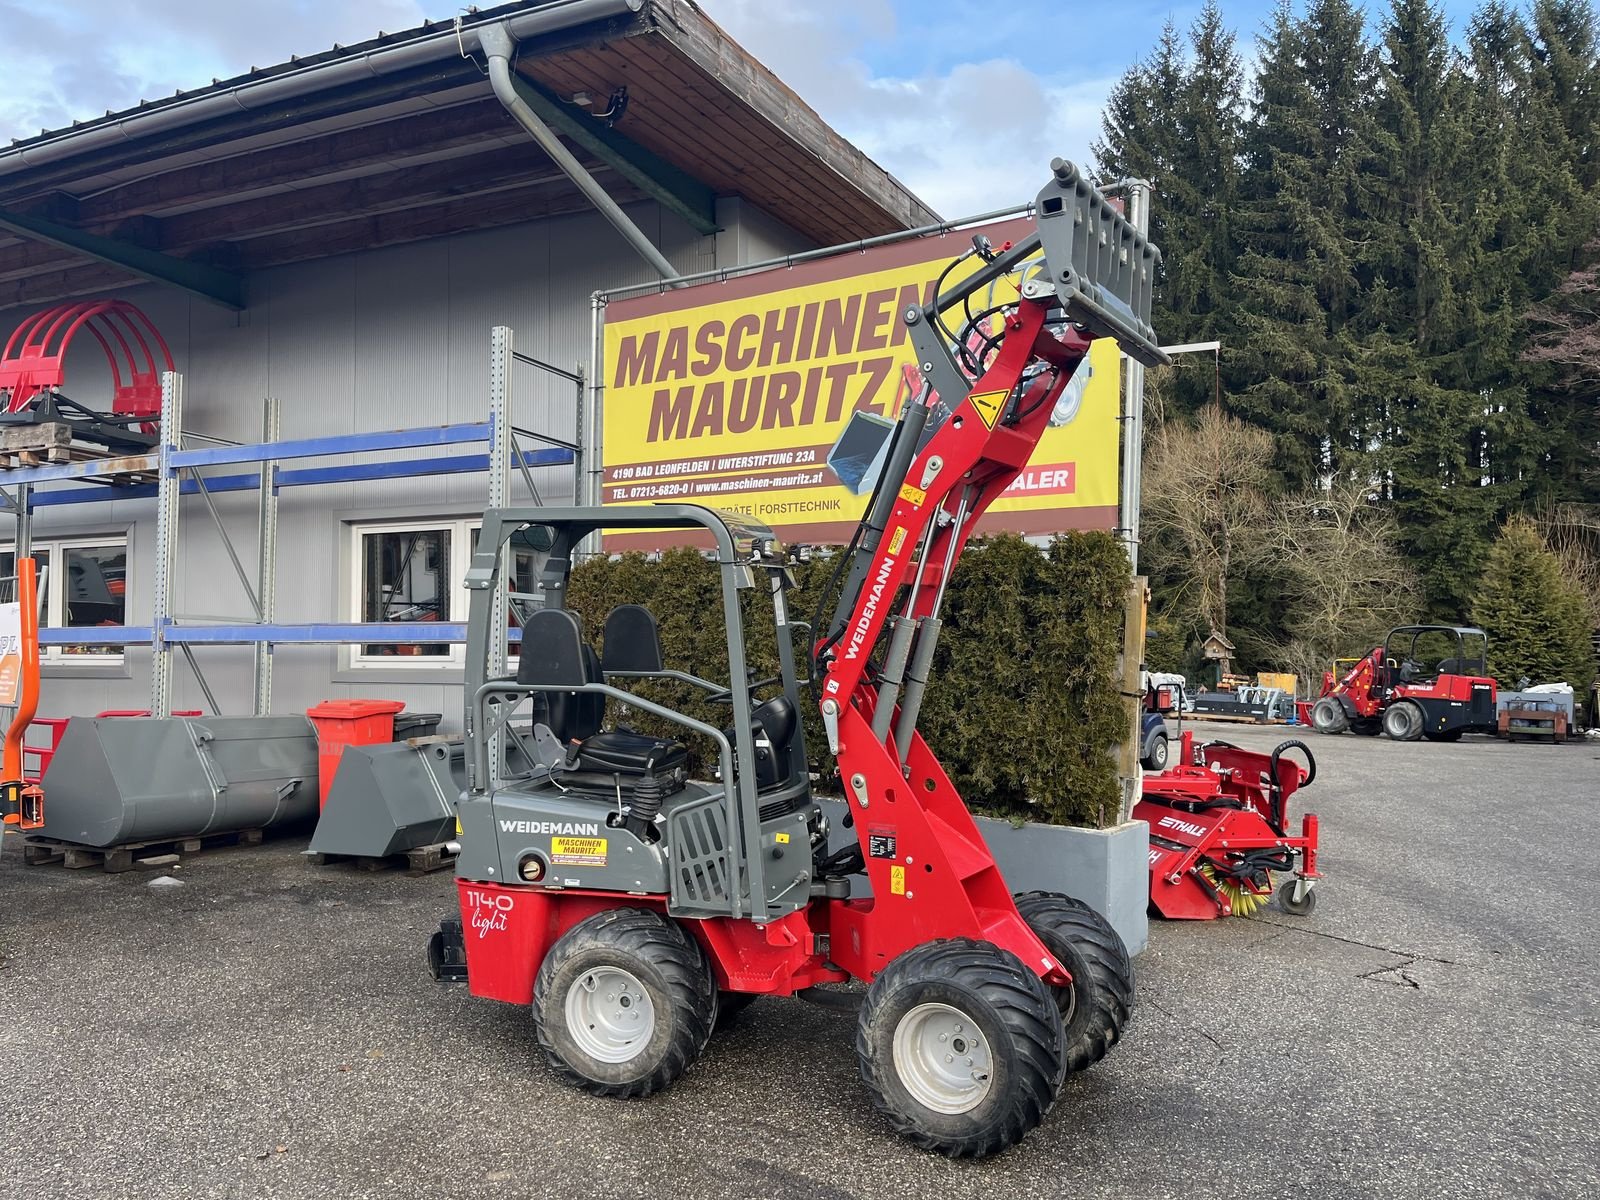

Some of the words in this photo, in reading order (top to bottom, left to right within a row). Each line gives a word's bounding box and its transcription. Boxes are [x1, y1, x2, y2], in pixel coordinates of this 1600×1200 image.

[614, 279, 936, 389] MASCHINEN
[646, 356, 893, 443] MAURITZ
[613, 468, 634, 480] 4190
[635, 467, 653, 478] BAD
[655, 460, 709, 476] LEONFELDEN
[718, 452, 792, 471] UNTERSTIFTUNG
[796, 450, 815, 463] 23A
[613, 488, 629, 499] TEL.
[630, 484, 688, 498] 07213-6820-0
[695, 471, 823, 493] www.maschinen-mauritz.at
[1006, 470, 1068, 491] ALER
[759, 499, 841, 515] FORSTTECHNIK
[845, 557, 895, 660] WEIDEMANN
[499, 820, 599, 836] WEIDEMANN
[1167, 818, 1207, 837] THALE
[558, 838, 602, 848] MASCHINEN
[563, 847, 597, 855] MAURITZ
[467, 891, 514, 911] 1140
[471, 907, 508, 939] light
